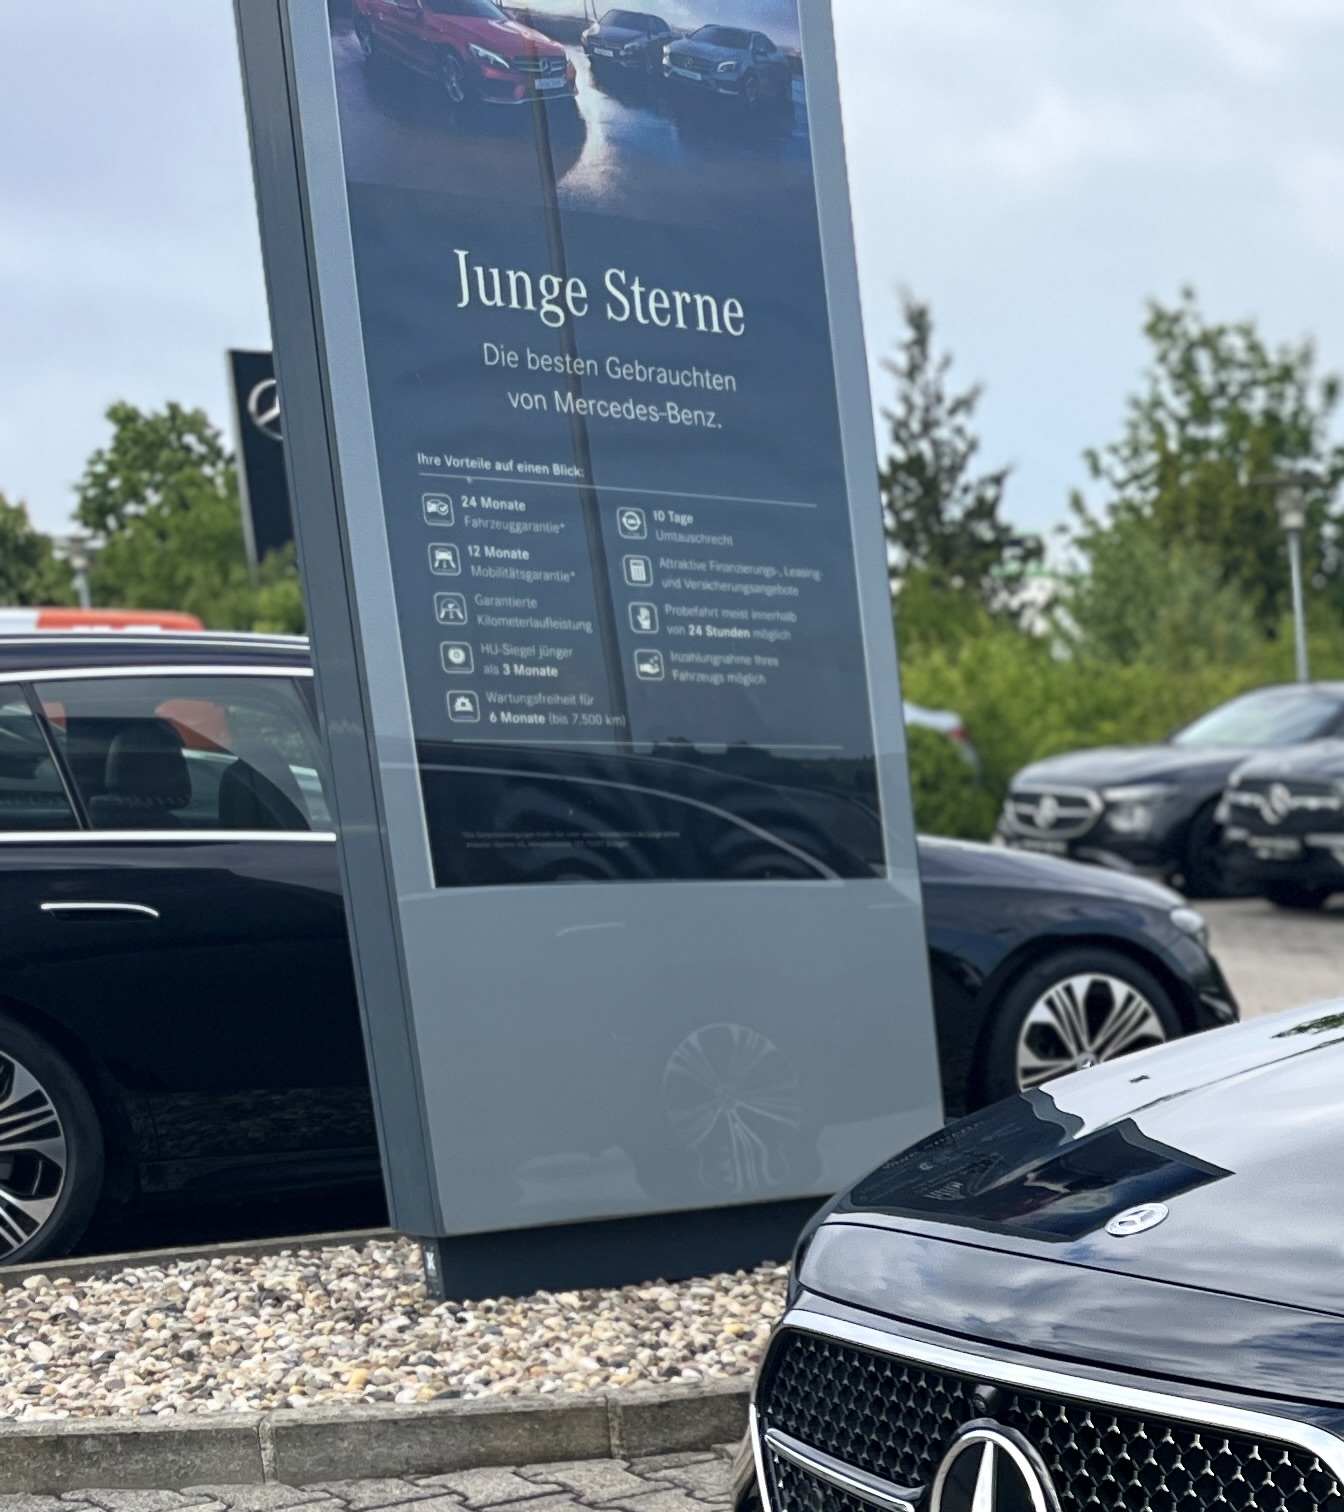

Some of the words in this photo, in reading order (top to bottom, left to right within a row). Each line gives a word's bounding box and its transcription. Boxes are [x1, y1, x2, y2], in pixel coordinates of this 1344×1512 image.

[453, 248, 588, 328] Junge
[604, 268, 745, 336] Sterne
[483, 343, 519, 368] Die
[526, 347, 598, 376] besten
[606, 356, 736, 392] Gebrauchten
[507, 391, 547, 411] von
[554, 390, 722, 429] Mercedes-Benz.
[417, 452, 441, 466] Ihre
[444, 454, 491, 470] Vorteile
[495, 460, 514, 472] auf
[517, 461, 550, 475] einen
[552, 463, 585, 478] Blick:
[461, 495, 477, 508] 24
[481, 497, 526, 511] Monate
[652, 510, 665, 522] 10
[668, 510, 694, 526] Tage
[655, 530, 734, 547] Umtauschrecht
[467, 545, 481, 557] 12
[484, 546, 530, 560] Monate
[662, 578, 681, 589] und
[474, 594, 538, 609] Garantierte
[664, 604, 719, 619] Probefahrt
[477, 615, 593, 634] Kilometerlaufleistung
[666, 626, 685, 636] von
[688, 624, 703, 636] 24
[706, 625, 750, 639] Stunden
[483, 665, 500, 675] als
[502, 664, 511, 675] 3
[513, 664, 558, 677] Monate
[489, 712, 497, 723] 6
[501, 712, 545, 725] Monate
